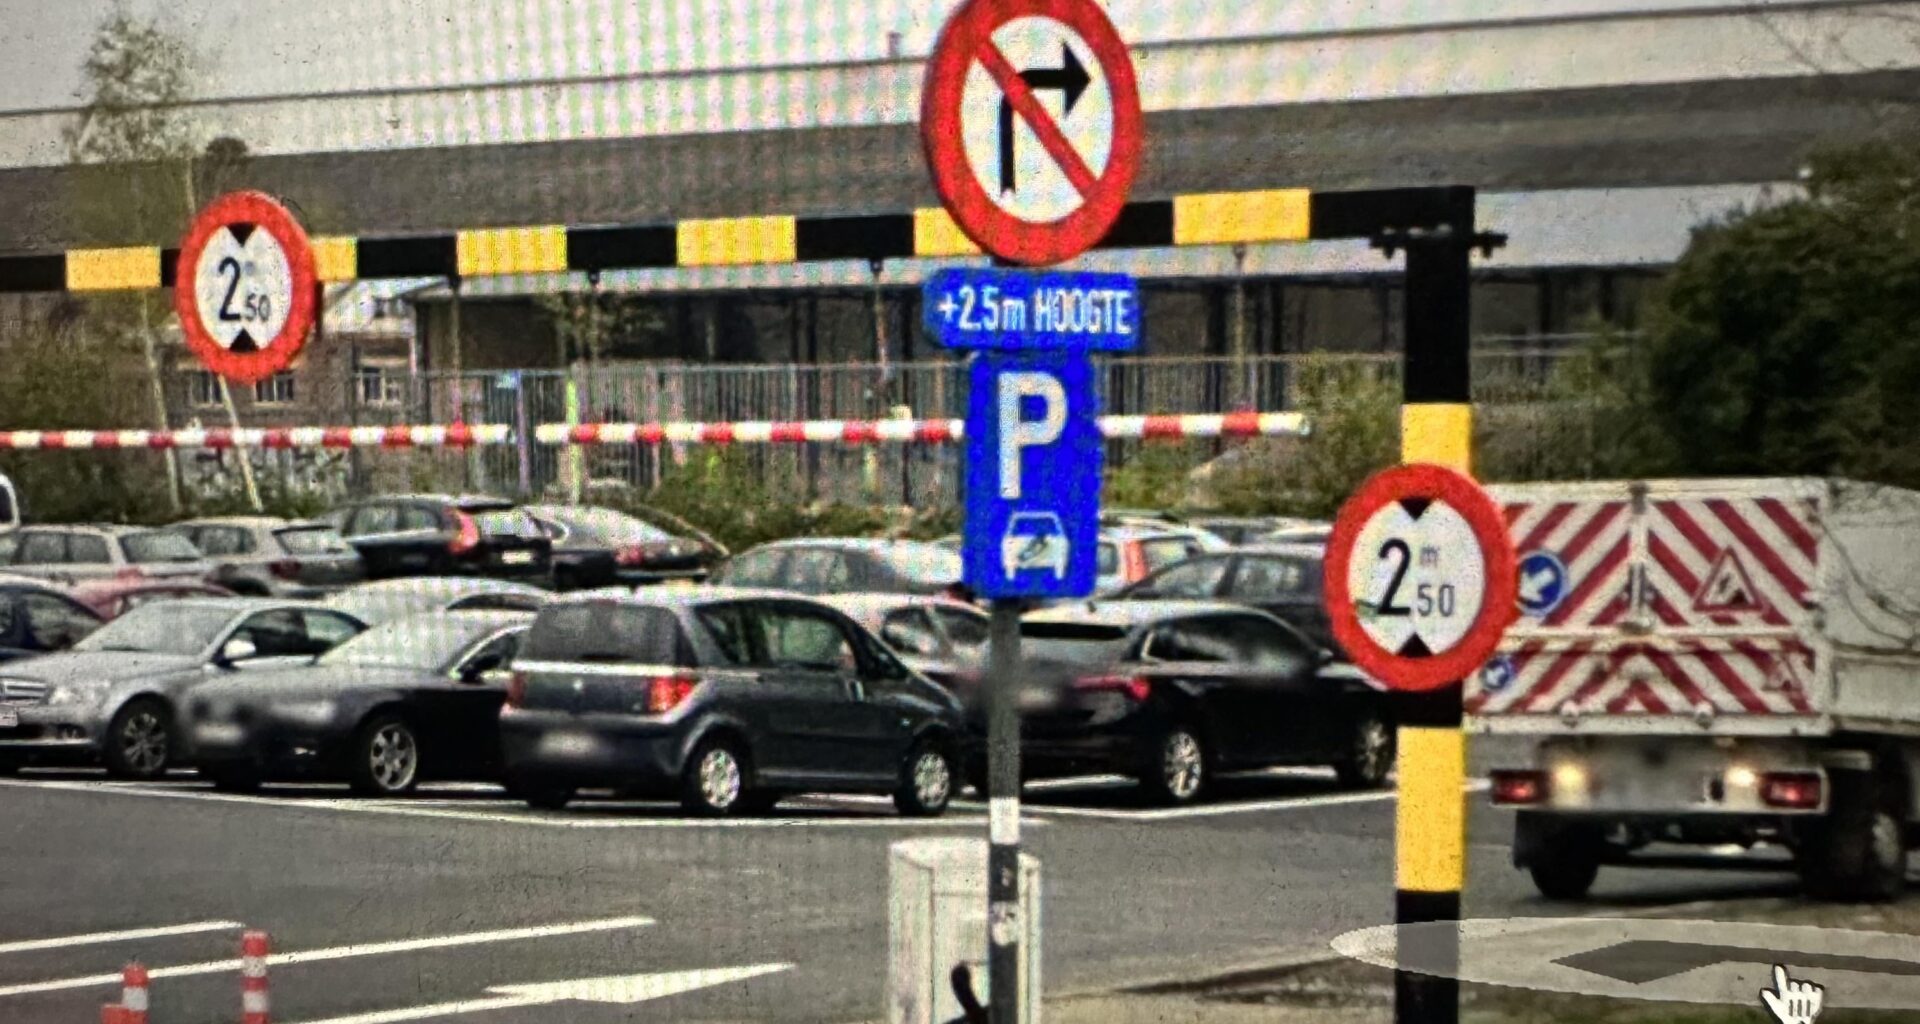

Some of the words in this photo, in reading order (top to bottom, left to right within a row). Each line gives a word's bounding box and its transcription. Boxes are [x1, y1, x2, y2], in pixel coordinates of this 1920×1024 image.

[219, 256, 241, 320] 2
[245, 293, 271, 322] 50
[1034, 287, 1132, 334] HOOGTE
[998, 371, 1067, 498] P
[1378, 538, 1411, 615] 2
[1417, 583, 1455, 617] 50
